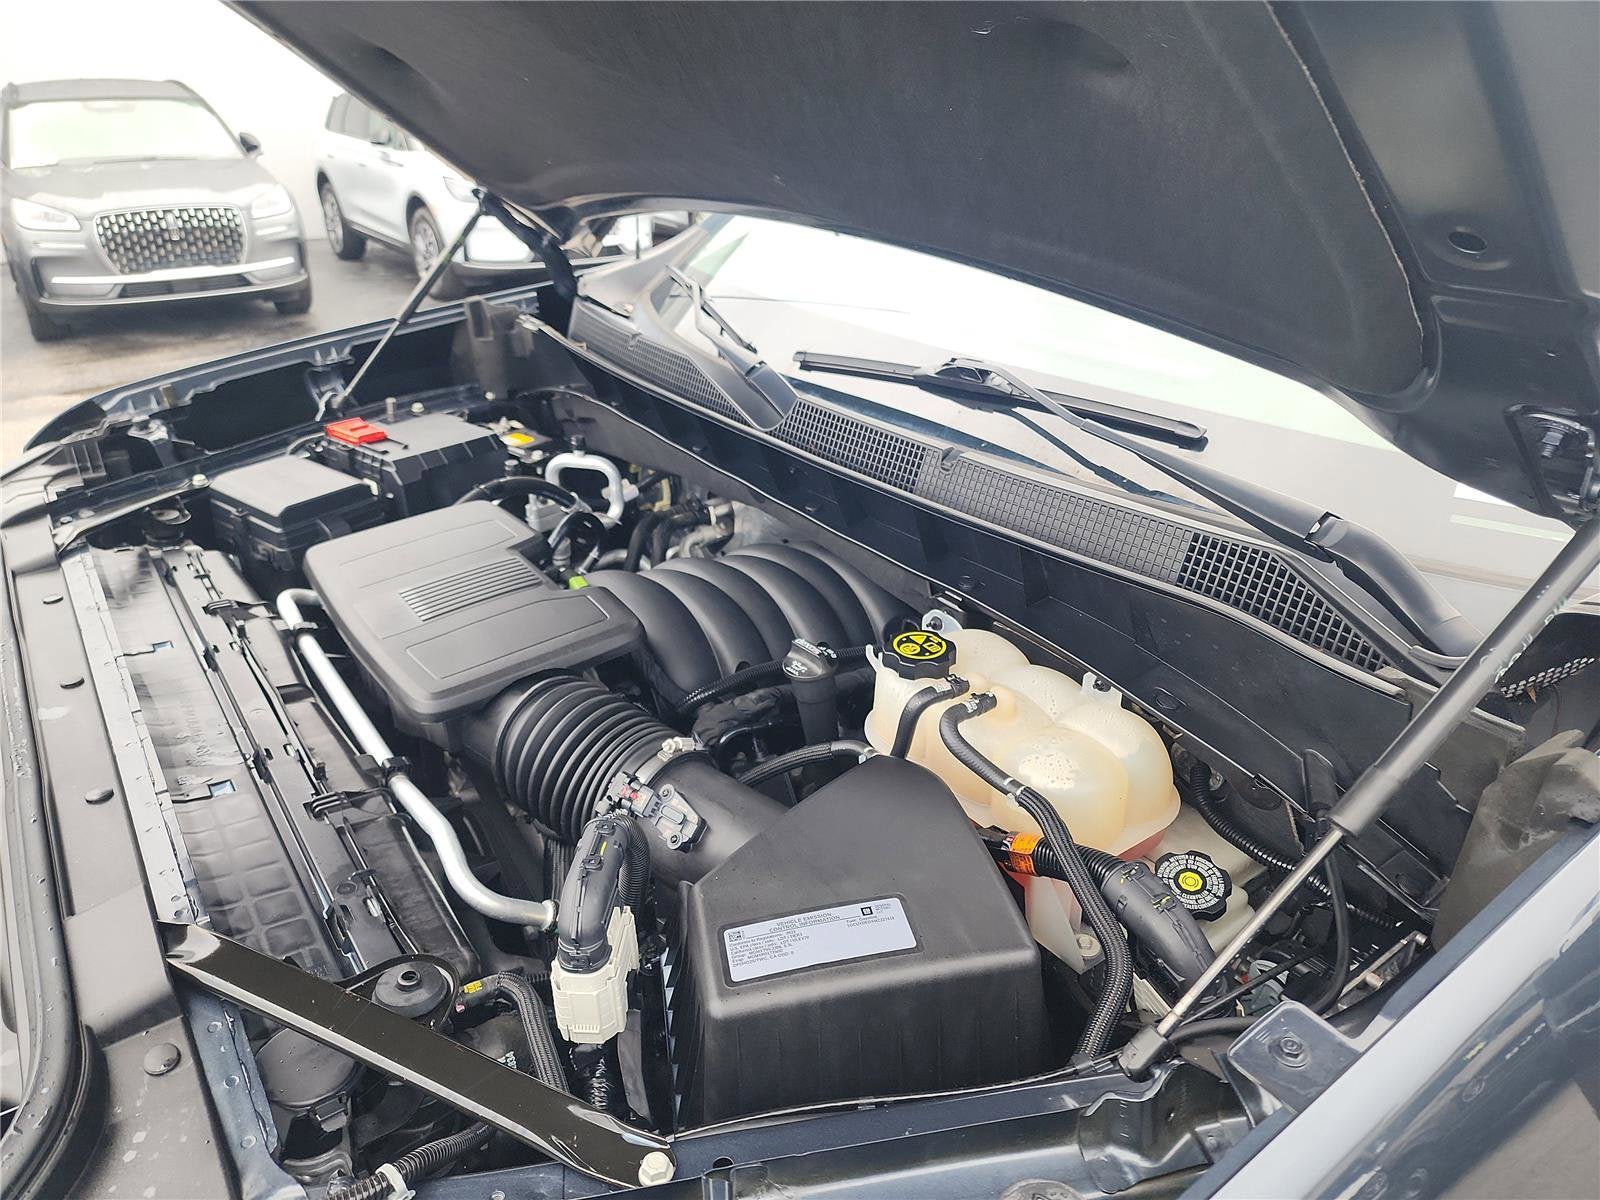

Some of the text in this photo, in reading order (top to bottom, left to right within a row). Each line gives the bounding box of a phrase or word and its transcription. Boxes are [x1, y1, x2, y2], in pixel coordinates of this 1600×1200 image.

[769, 924, 797, 933] CONTROL
[799, 915, 840, 926] INFORMATION
[776, 912, 831, 927] VEHICLE EMISSION
